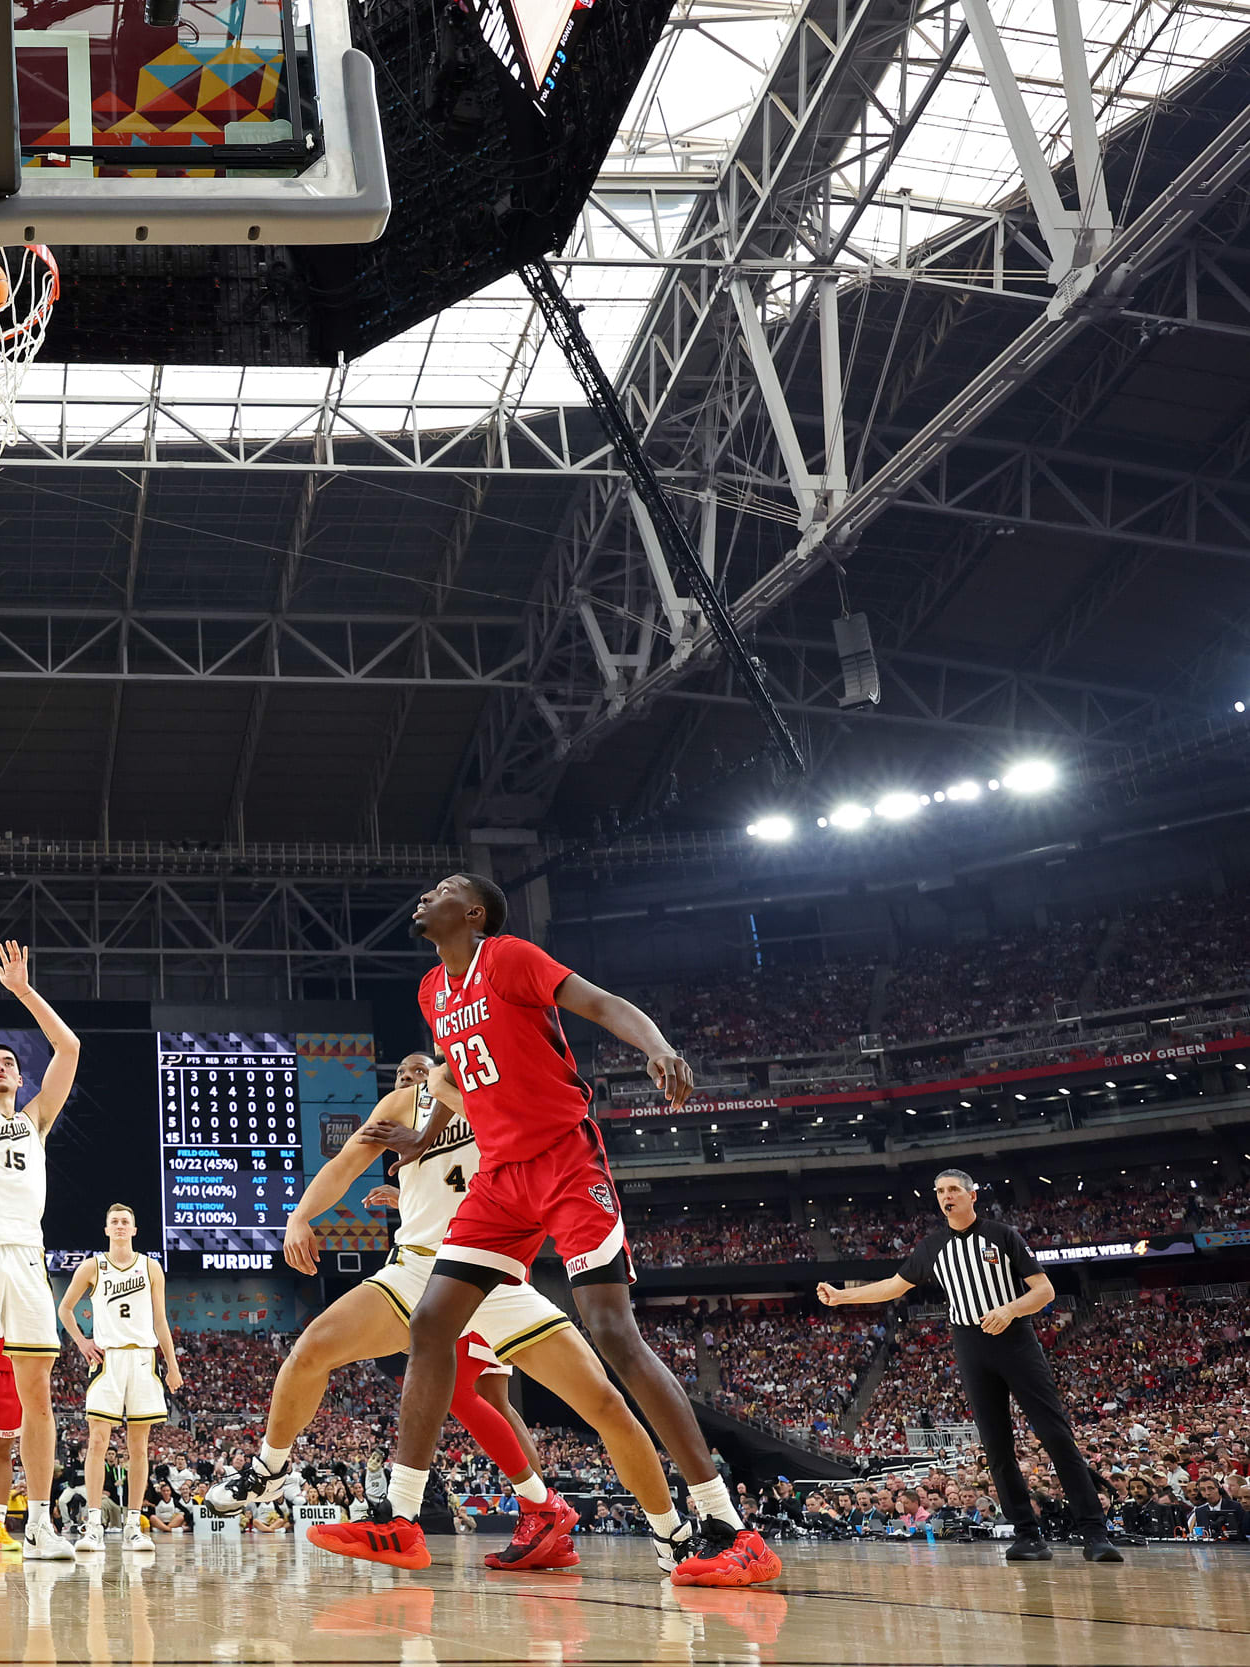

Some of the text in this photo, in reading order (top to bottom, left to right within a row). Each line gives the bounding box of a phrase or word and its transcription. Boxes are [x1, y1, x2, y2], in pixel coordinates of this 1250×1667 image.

[559, 18, 575, 47] BONUS
[435, 996, 490, 1039] NC STATE
[1122, 1052, 1151, 1064] ROY
[1157, 1043, 1206, 1059] GREEN
[449, 1033, 500, 1093] 23
[167, 1071, 234, 1081] 2 3 1
[168, 1086, 255, 1097] 3 0 4 4 2
[167, 1101, 218, 1112] 4 4 2
[630, 1107, 661, 1117] JOHN
[718, 1099, 777, 1110] DRISCOLL
[169, 1117, 200, 1127] 5 0
[325, 1123, 353, 1134] FINAL
[166, 1132, 236, 1143] 15 11 5 1
[327, 1134, 350, 1145] FOU
[5, 1149, 26, 1171] 15
[169, 1158, 292, 1171] 10/22 (45%) 16 0
[443, 1164, 466, 1192] 4
[172, 1185, 294, 1198] 4/10 (40%) 6 4
[174, 1212, 265, 1225] 3/3 (100%) 3
[1035, 1250, 1060, 1261] HEN
[1060, 1246, 1098, 1259] THERE
[1098, 1244, 1132, 1256] WERE
[203, 1254, 273, 1269] PURDUE
[103, 1276, 146, 1296] Purdue
[119, 1303, 131, 1318] 2
[300, 1508, 336, 1519] BOILER
[211, 1520, 225, 1532] UP
